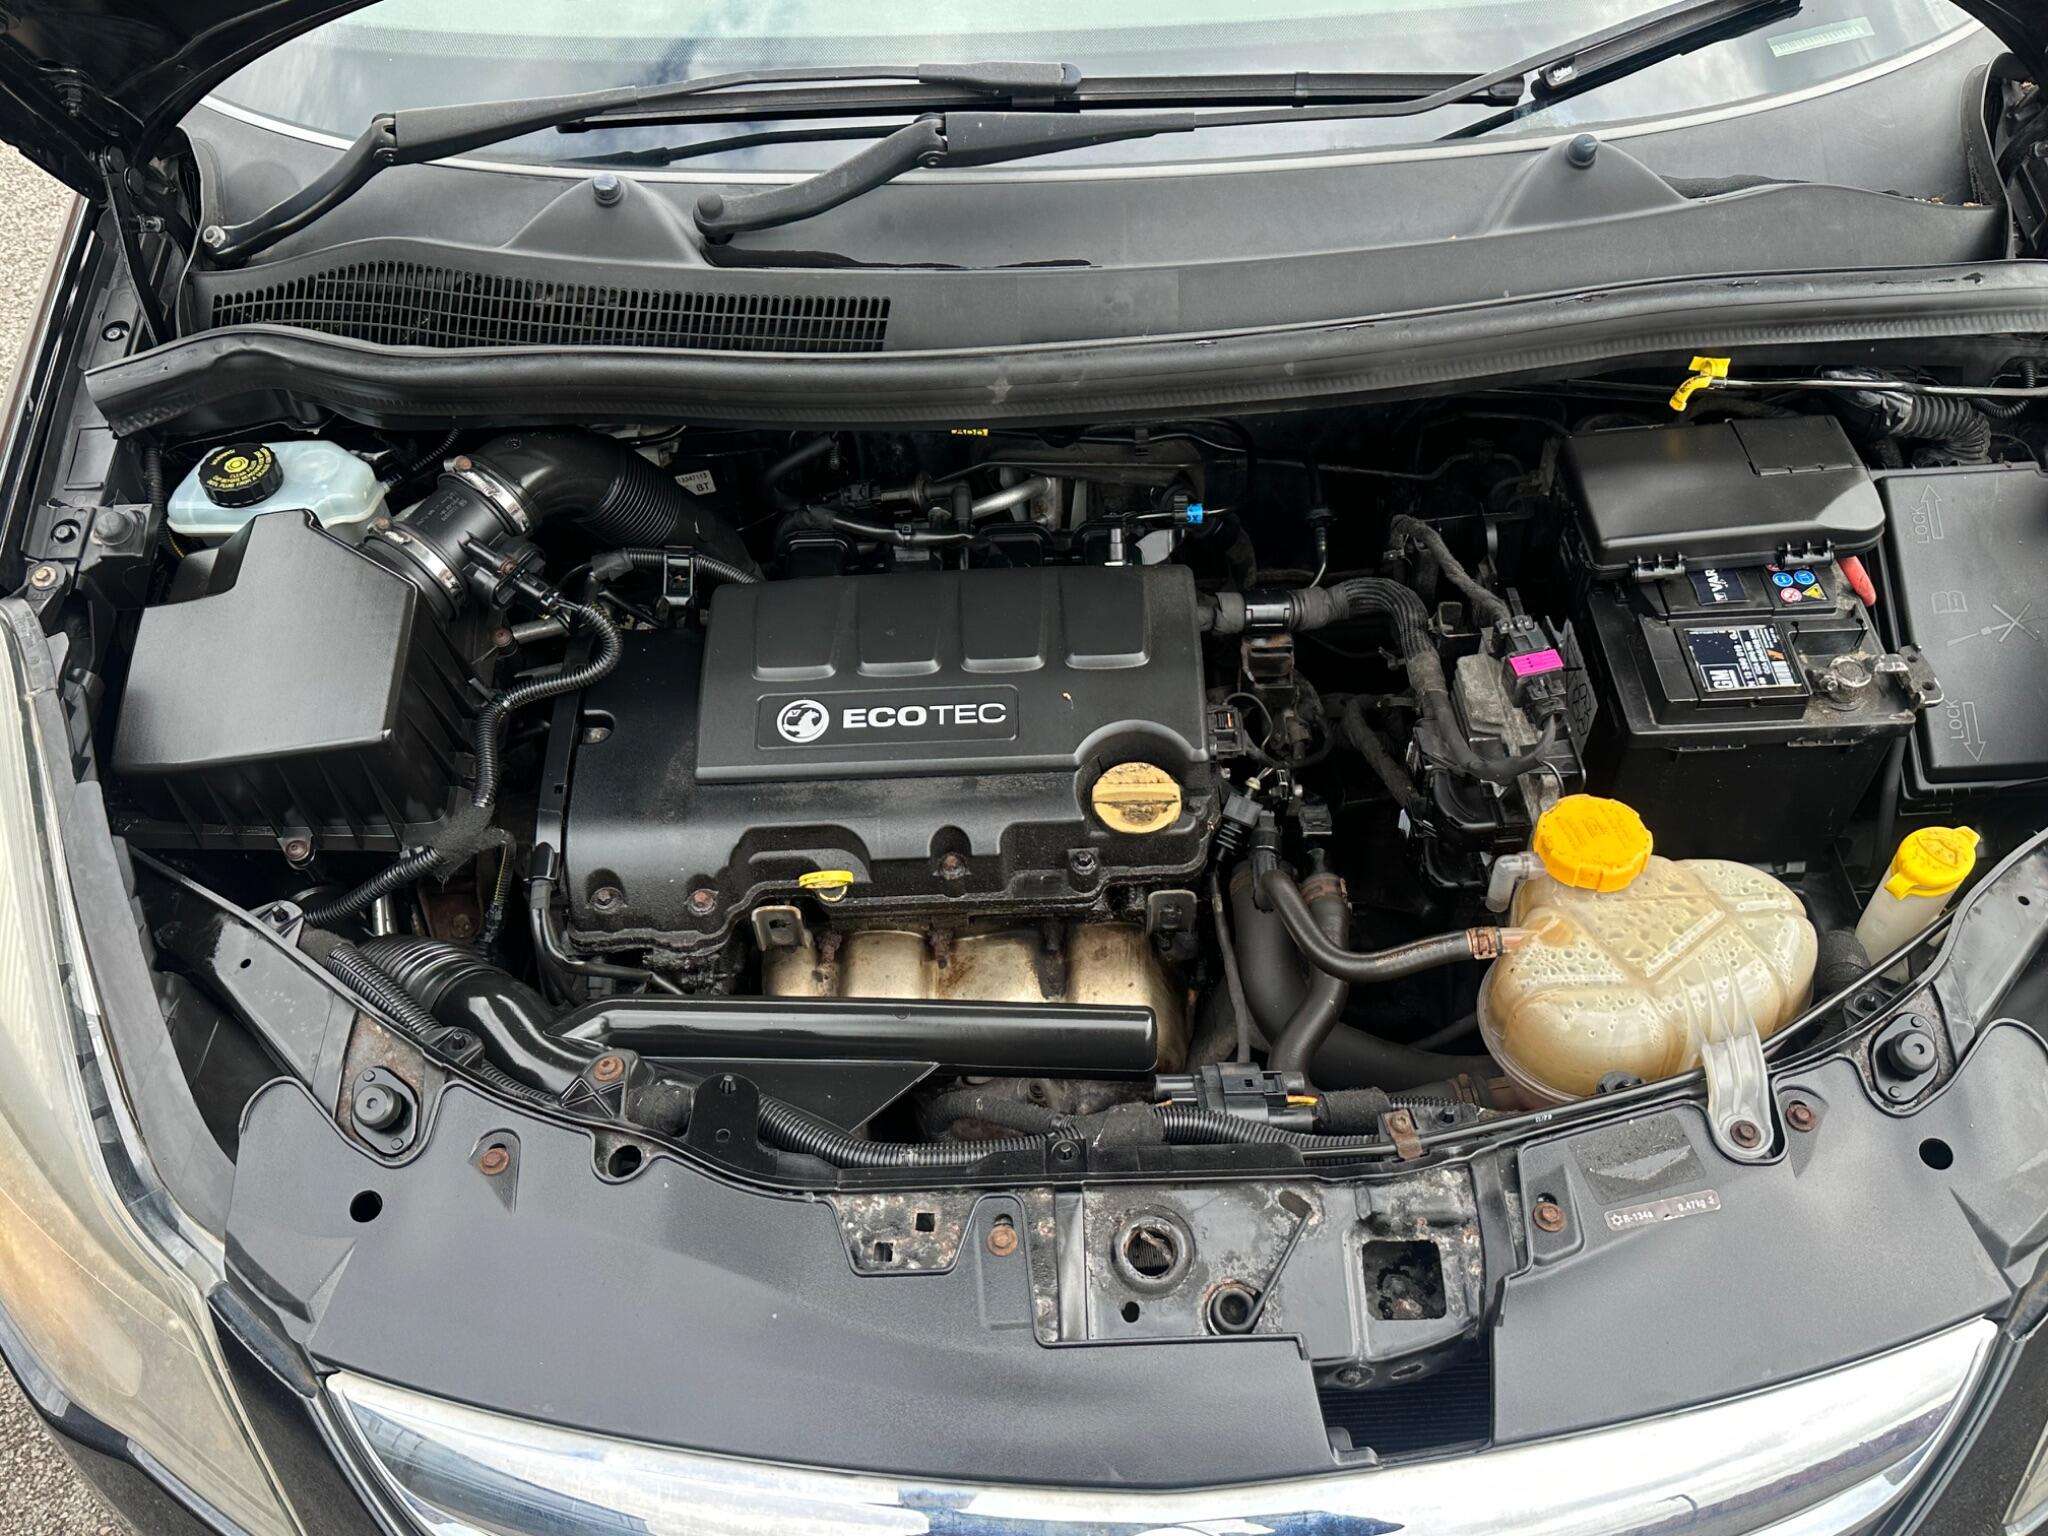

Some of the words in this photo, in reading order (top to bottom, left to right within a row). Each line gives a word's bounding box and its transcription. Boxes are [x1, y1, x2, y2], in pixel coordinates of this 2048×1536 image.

[1911, 505, 1930, 544] LOCK
[1709, 669, 1734, 689] GM
[843, 703, 1007, 729] ECOTEC
[1946, 699, 1965, 740] LOCK
